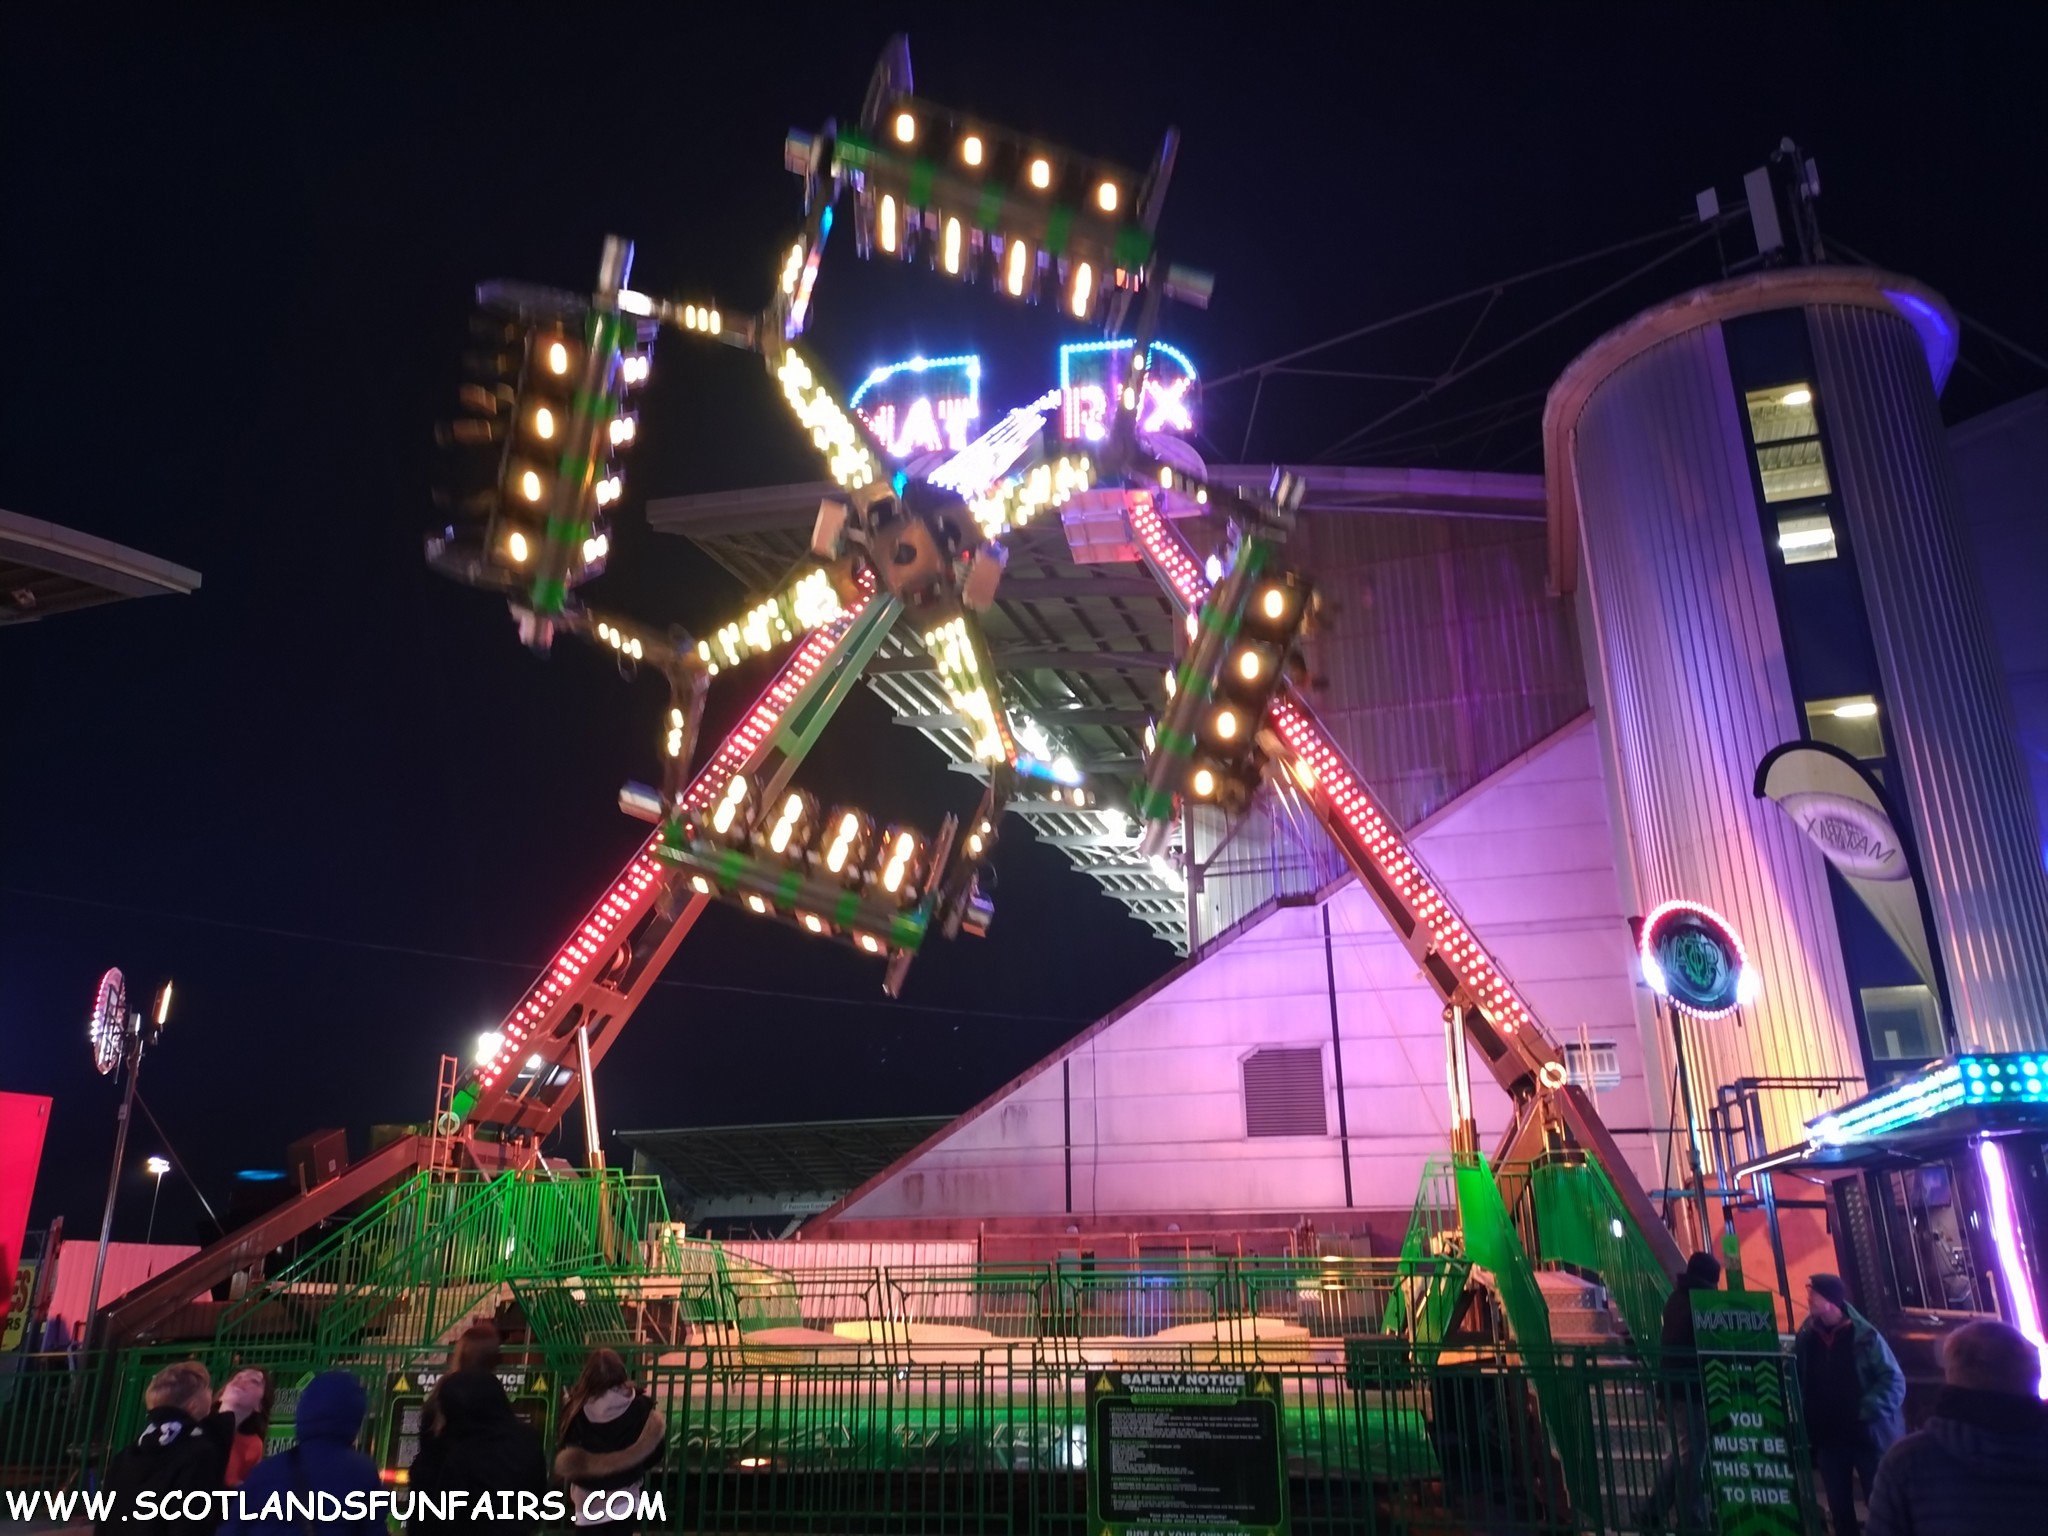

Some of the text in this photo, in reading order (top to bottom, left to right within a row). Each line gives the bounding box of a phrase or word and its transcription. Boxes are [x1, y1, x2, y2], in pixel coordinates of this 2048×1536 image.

[1694, 1310, 1772, 1331] MATRIX
[1121, 1373, 1246, 1386] SAFETY NOTICE
[1129, 1385, 1176, 1393] Technical
[1206, 1386, 1239, 1394] Matrix
[1729, 1412, 1763, 1428] YOU
[1713, 1436, 1786, 1454] MUST BE
[1712, 1461, 1794, 1479] THIS TALL
[1723, 1486, 1791, 1505] TO RIDE
